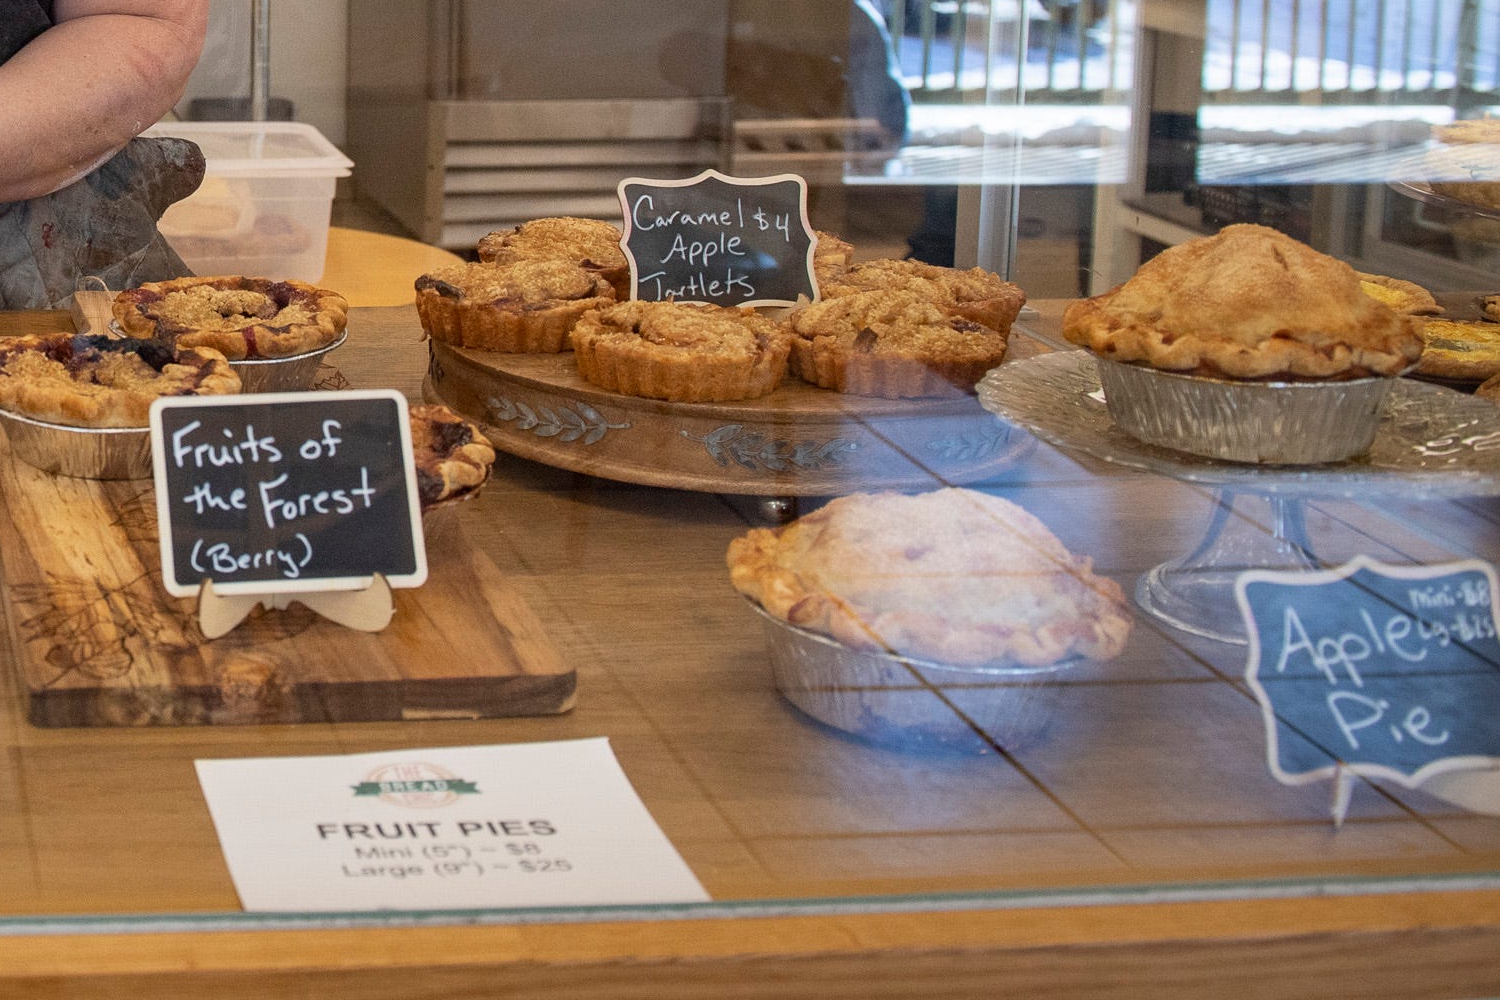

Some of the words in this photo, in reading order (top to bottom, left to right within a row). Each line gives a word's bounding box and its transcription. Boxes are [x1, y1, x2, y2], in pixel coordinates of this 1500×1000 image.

[632, 194, 744, 231] Caramel
[752, 206, 790, 242] $4
[660, 232, 746, 267] Apple
[638, 268, 756, 301] Tartlets
[171, 420, 283, 468] Fruits
[299, 419, 342, 459] of
[184, 481, 246, 514] the
[258, 466, 376, 529] Forest
[190, 533, 313, 578] (Berry)
[1276, 604, 1429, 688] Apple
[1326, 690, 1449, 750] Pie
[315, 822, 442, 840] FRUIT
[456, 820, 558, 837] PIES
[342, 864, 424, 880] Large
[518, 859, 574, 873] $25
[354, 846, 414, 860] Mini
